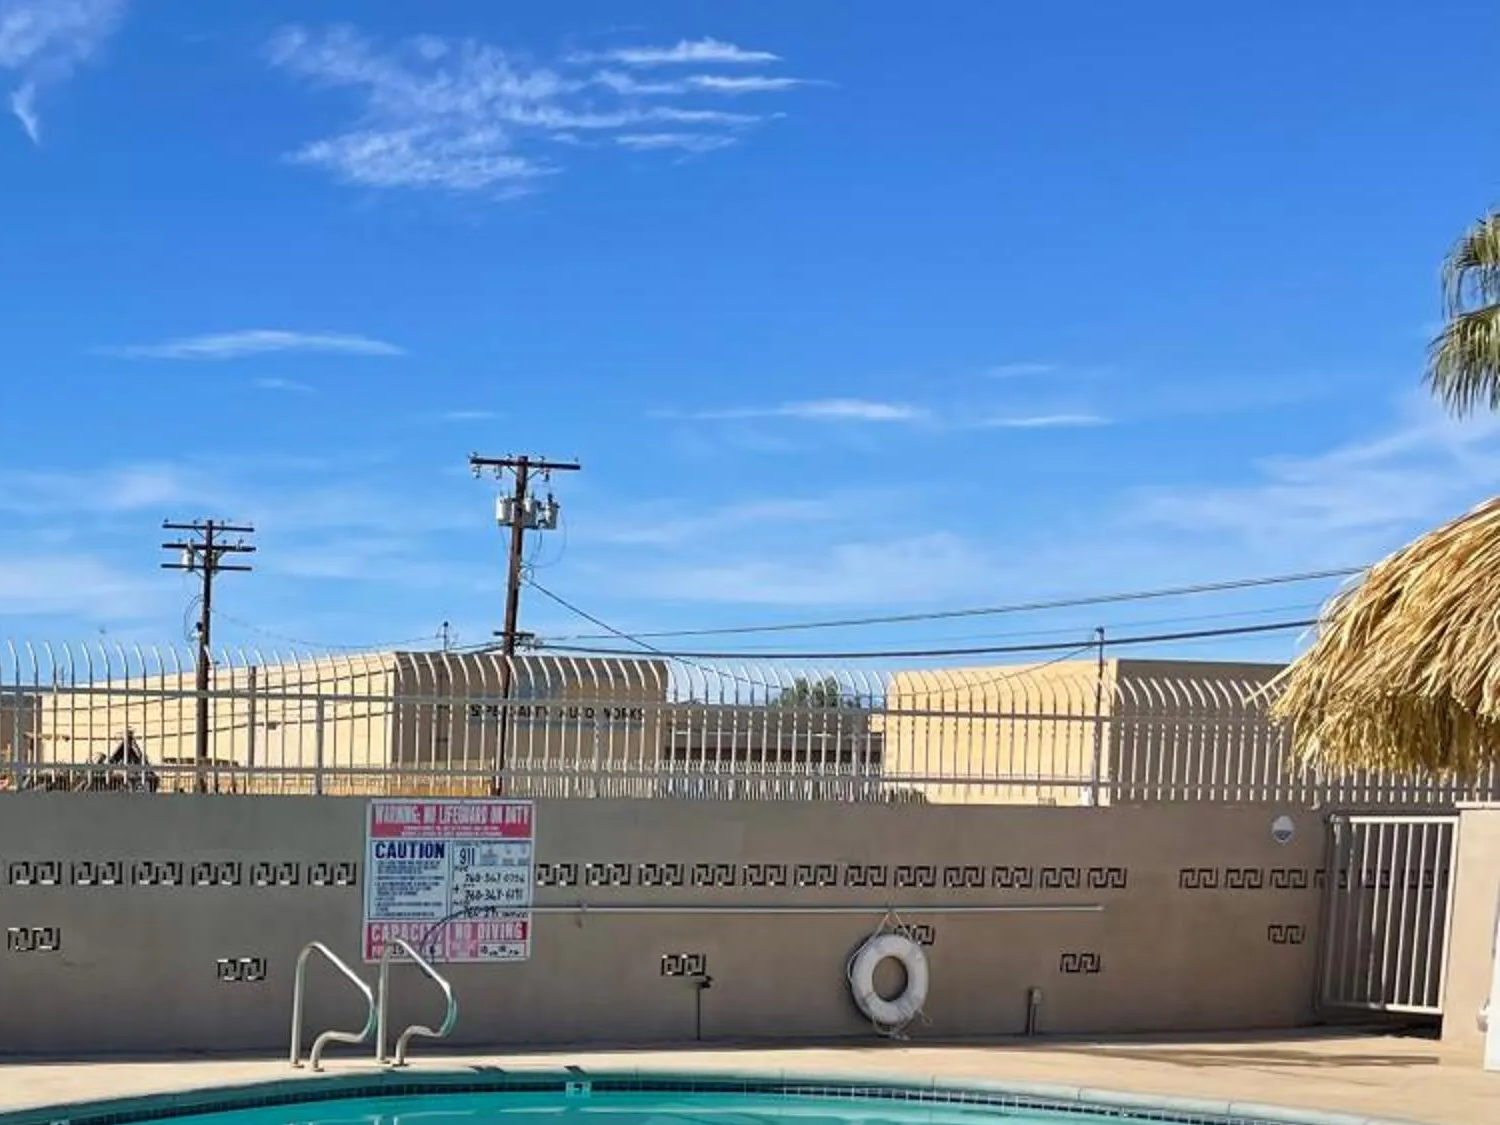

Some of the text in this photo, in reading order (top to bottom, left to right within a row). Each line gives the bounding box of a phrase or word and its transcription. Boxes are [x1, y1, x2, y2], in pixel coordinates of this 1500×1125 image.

[375, 841, 445, 859] CAUTION
[459, 847, 475, 866] 911
[371, 922, 443, 942] CAPACITY
[456, 922, 523, 940] NO DIVING
